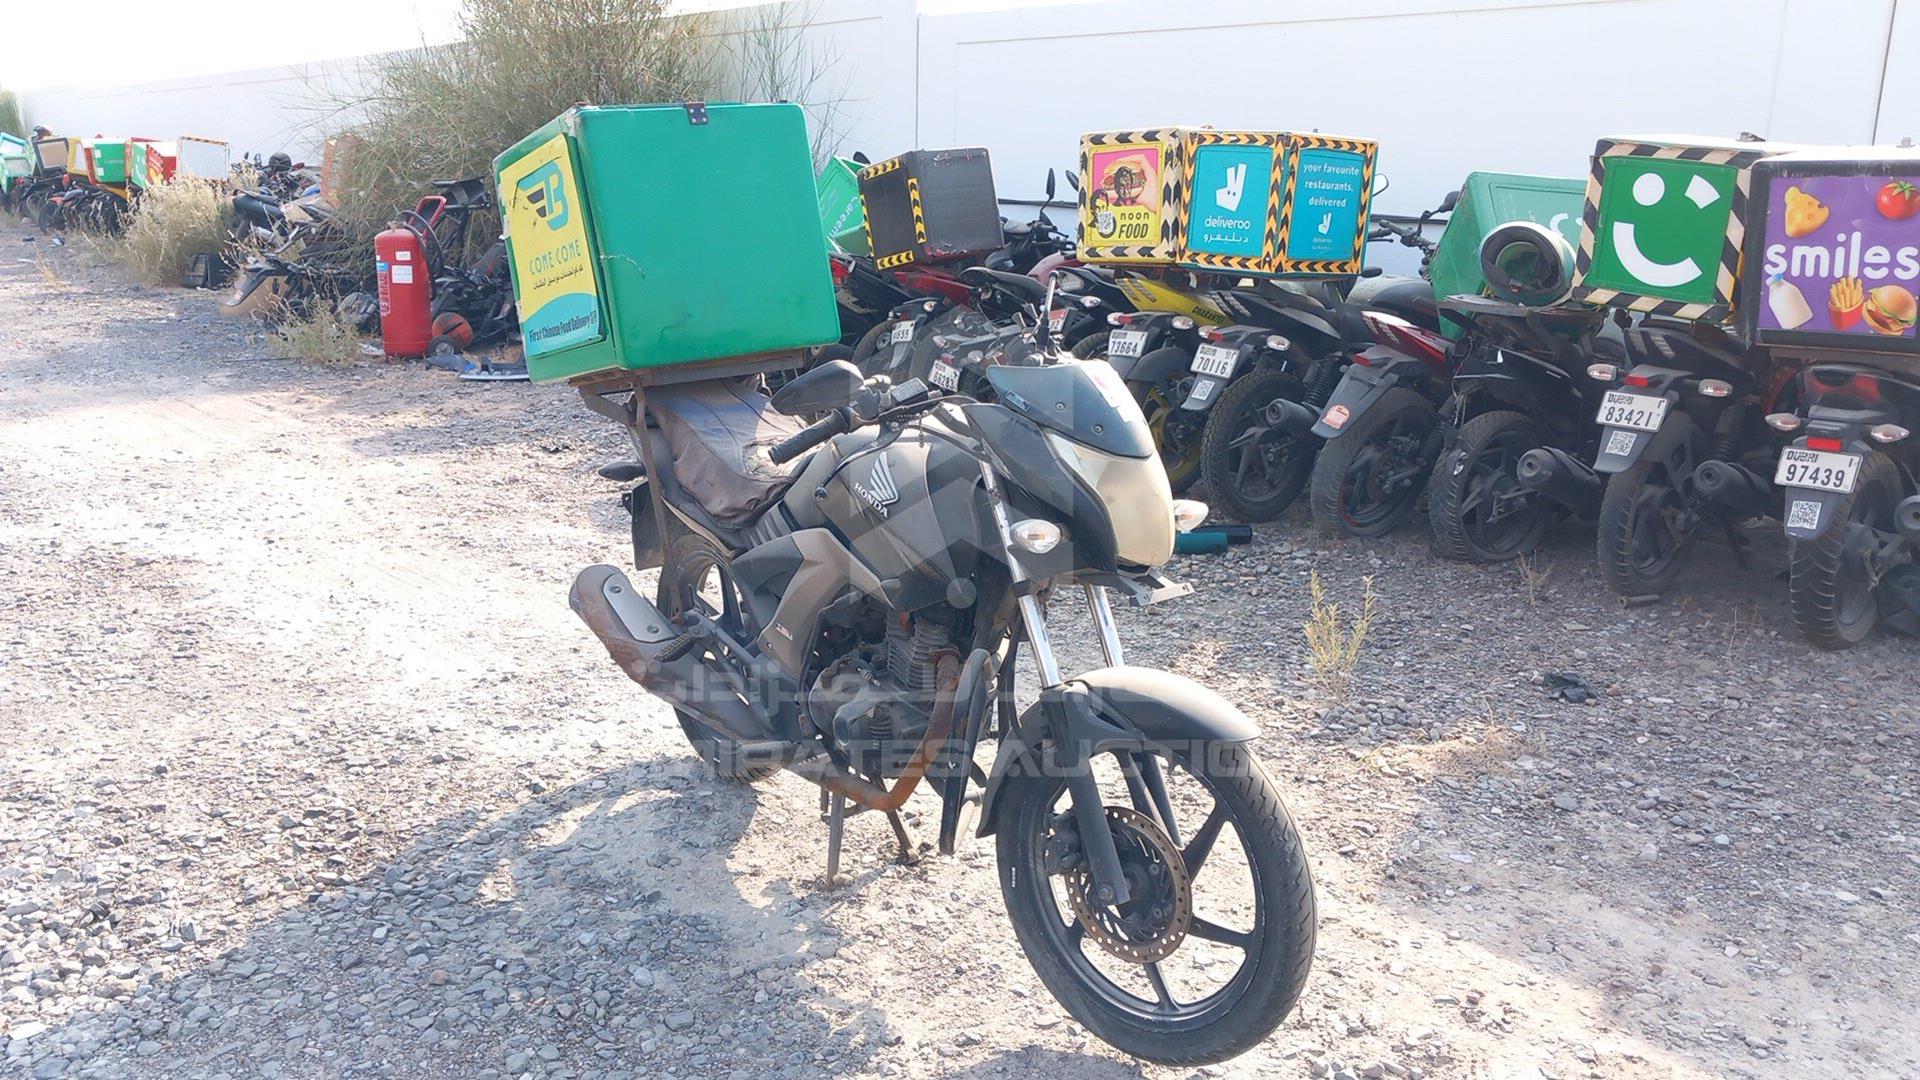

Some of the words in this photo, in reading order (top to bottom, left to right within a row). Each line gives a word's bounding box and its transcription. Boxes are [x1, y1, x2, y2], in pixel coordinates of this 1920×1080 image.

[1303, 163, 1322, 174] your
[1323, 163, 1360, 176] favourite
[1308, 196, 1347, 207] delivered
[1120, 212, 1150, 220] noon
[1204, 215, 1251, 230] deliveroo
[1118, 223, 1149, 239] FOOD
[529, 251, 554, 275] COME
[556, 239, 582, 264] COME
[1764, 231, 1920, 280] smiles
[529, 328, 542, 343] First
[542, 322, 560, 341] Chinese
[559, 318, 571, 336] Food
[1110, 341, 1138, 355] 73664
[1196, 356, 1229, 375] 70116
[1605, 406, 1653, 428] 83421
[1786, 450, 1819, 463] DUBAI
[1786, 463, 1845, 488] 97439
[854, 482, 889, 519] HONDA
